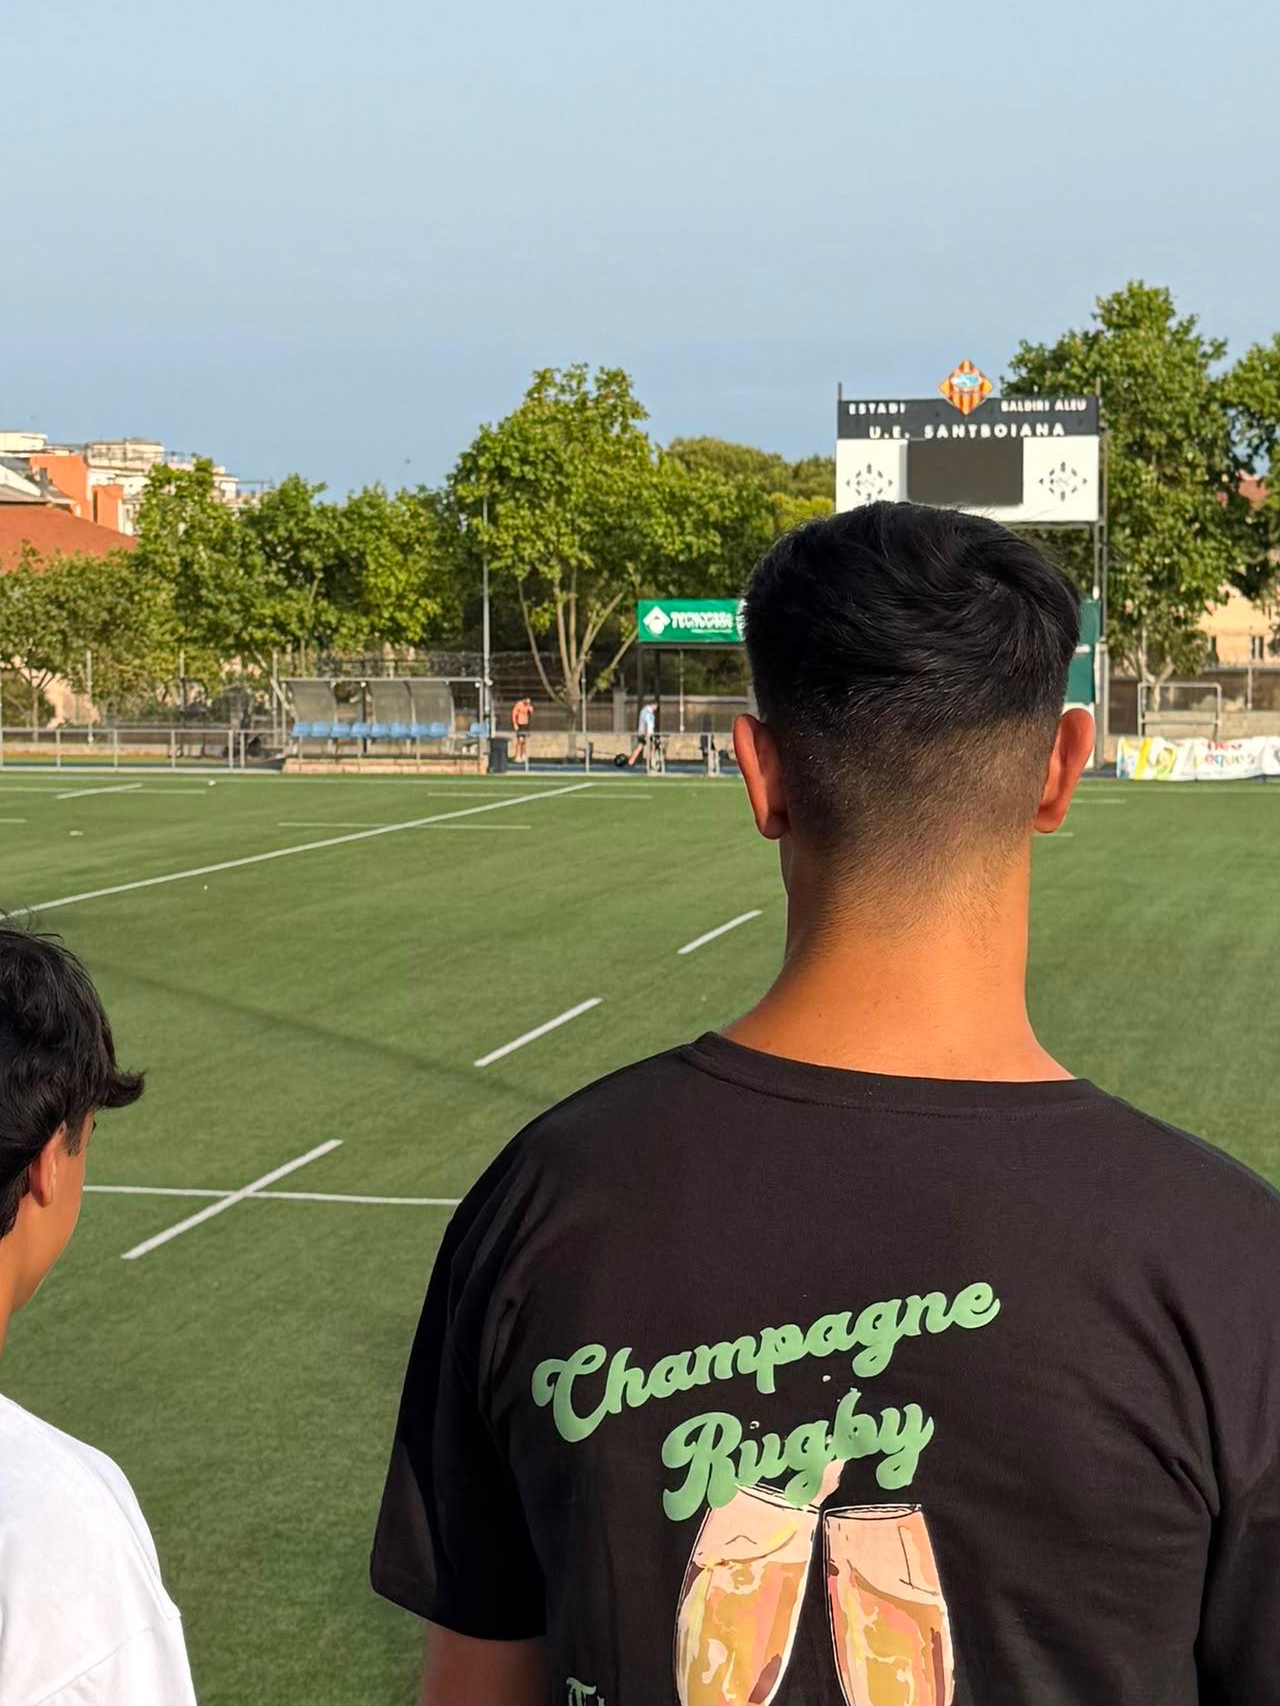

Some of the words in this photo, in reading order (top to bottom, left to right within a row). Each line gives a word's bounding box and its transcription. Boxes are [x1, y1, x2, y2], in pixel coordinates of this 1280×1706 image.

[849, 403, 906, 415] ESTADI
[1001, 400, 1049, 412] BALDIRI
[1055, 399, 1087, 411] ALEU
[870, 426, 910, 439] U.E.
[924, 422, 1065, 439] SANTBOIANA
[532, 1282, 1000, 1443] Champagne
[661, 1388, 934, 1521] Rugby
